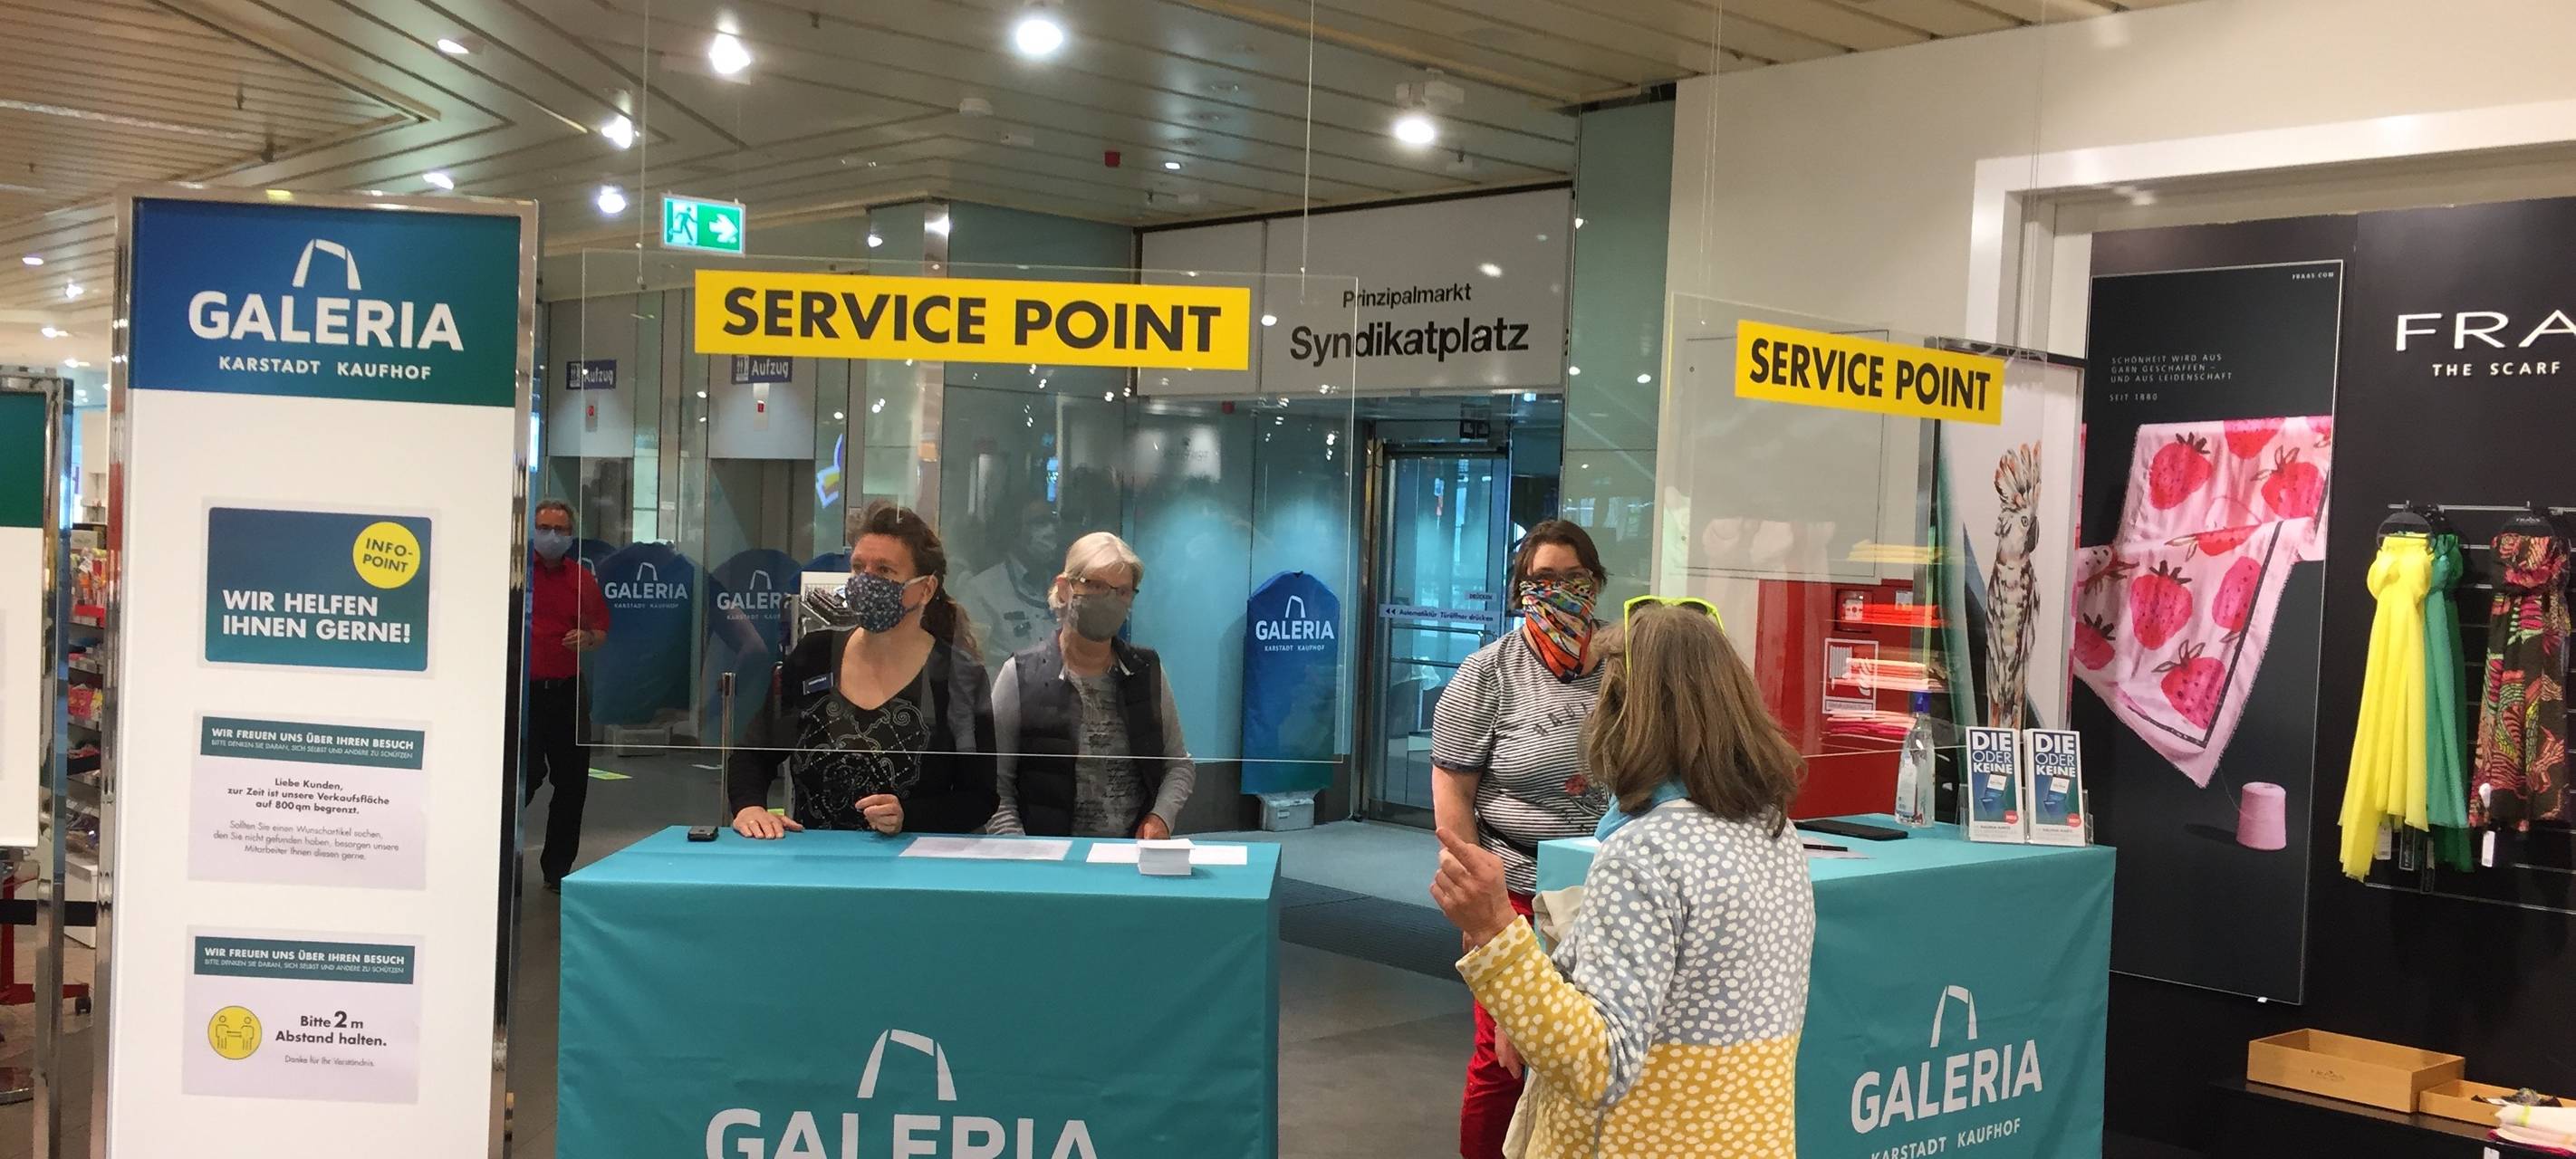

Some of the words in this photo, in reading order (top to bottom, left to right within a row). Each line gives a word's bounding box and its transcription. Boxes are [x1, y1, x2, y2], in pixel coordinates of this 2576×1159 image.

[1342, 283, 1472, 309] Prinzipalmarkt
[188, 290, 465, 351] GALERIA
[723, 286, 986, 345] SERVICE
[1014, 299, 1222, 353] POINT
[2396, 309, 2576, 351] FRA
[1290, 317, 1530, 368] Syndikatplatz
[2171, 354, 2197, 362] WIRD
[2202, 353, 2223, 361] AUS
[218, 355, 321, 375] KARSTADT
[337, 361, 432, 380] KAUFHOF
[751, 359, 789, 378] Aufzug
[1749, 338, 1884, 398] SERVICE
[1896, 359, 1991, 411] POINT
[2110, 365, 2138, 374] GARN
[2141, 363, 2206, 373] GESCHAFFEN
[2432, 363, 2473, 377] THE
[2490, 361, 2561, 376] SCARF
[2110, 374, 2129, 383] UND
[2135, 374, 2154, 382] AUS
[2158, 372, 2233, 382] LEIDENSCHAFT
[2109, 393, 2129, 401] SEIT
[365, 538, 414, 557] INFO-
[362, 553, 409, 573] POINT
[604, 581, 688, 599] GALERIA
[222, 589, 275, 612] WIR
[284, 592, 379, 617] HELFEN
[223, 615, 307, 638] IHNEN
[315, 619, 411, 644] GERNE!
[1255, 620, 1335, 641] GALERIA
[1297, 644, 1325, 652] KAUFHOF
[211, 727, 233, 738] WIR
[236, 730, 276, 742] FREUEN
[280, 732, 303, 742] UNS
[306, 732, 333, 745] ÜBER
[336, 735, 370, 747] IHREN
[372, 738, 414, 751] BESUCH
[1971, 731, 2012, 752] DIE
[2034, 733, 2075, 755] DIE
[1972, 750, 2013, 763] ODER
[2035, 752, 2075, 767] ODER
[1973, 762, 2014, 774] KEINE
[2036, 764, 2076, 778] KEINE
[274, 778, 300, 788] Liebe
[303, 780, 343, 791] Kunden,
[227, 787, 243, 795] zur
[246, 787, 264, 797] Zeit
[267, 789, 279, 798] ist
[282, 791, 314, 800] unsere
[317, 792, 390, 805] Verkaufsfläche
[255, 800, 272, 808] auf
[313, 803, 360, 814] begrenzt.
[213, 829, 228, 839] den
[230, 832, 243, 840] Sie
[245, 832, 264, 842] nicht
[204, 946, 226, 957] WIR
[228, 947, 269, 959] FREUEN
[272, 950, 295, 960] UNS
[298, 949, 324, 962] ÜBER
[328, 953, 360, 963] IHREN
[363, 954, 405, 965] BESUCH
[300, 1015, 332, 1028] Bitte
[333, 1010, 348, 1029] 2
[351, 1020, 364, 1029] m
[275, 1030, 334, 1044] Abstand
[339, 1032, 388, 1047] halten.
[1850, 1039, 2043, 1134] GALERIA
[705, 1107, 1099, 1159] GALERIA
[1956, 1117, 2022, 1148] KAUFHOF
